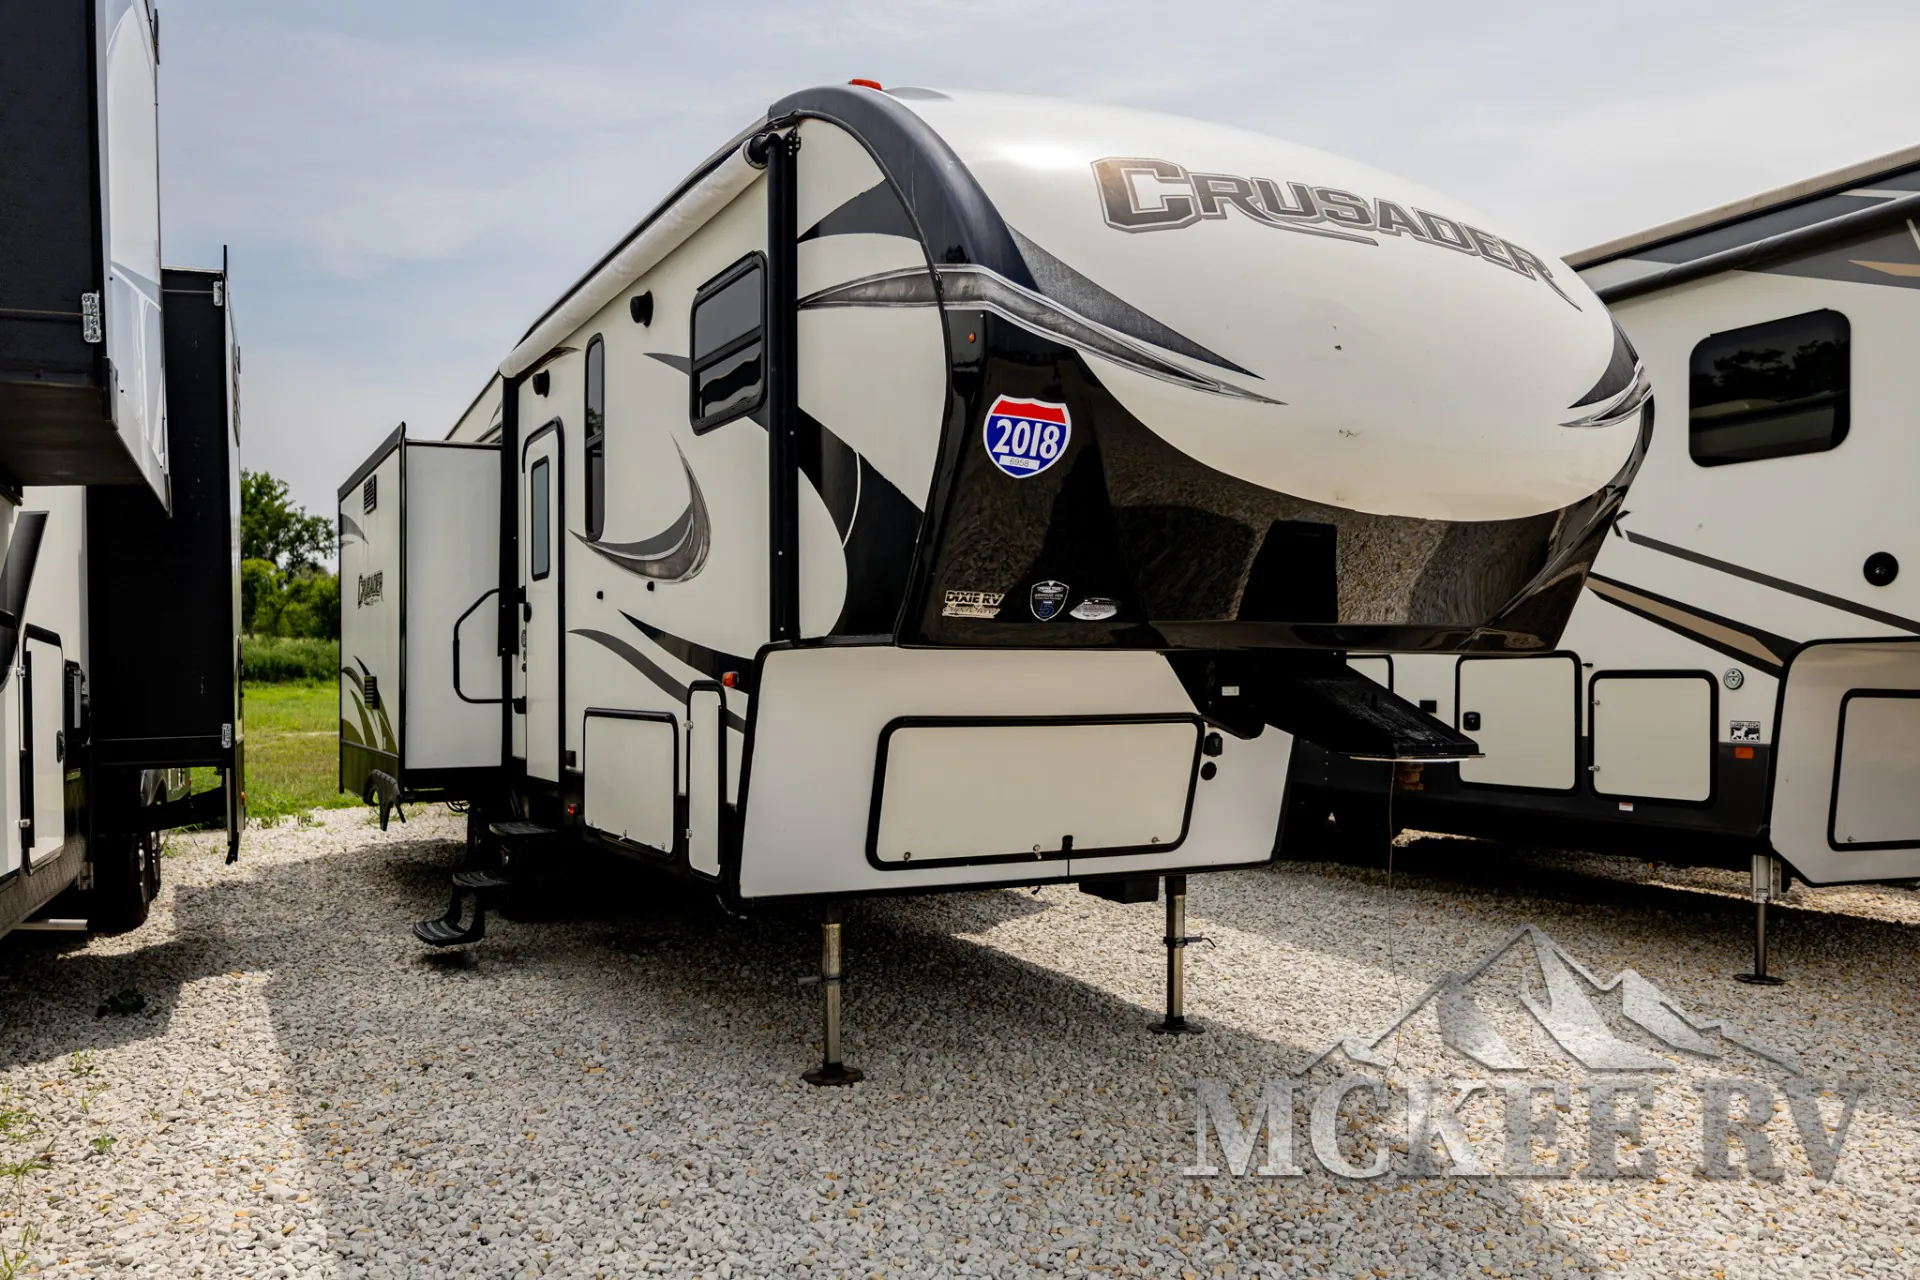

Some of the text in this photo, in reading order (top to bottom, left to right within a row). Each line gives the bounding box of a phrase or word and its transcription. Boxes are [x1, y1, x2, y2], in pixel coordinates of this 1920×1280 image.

[1090, 156, 1583, 312] CRUSADER
[992, 418, 1060, 460] 2018
[945, 590, 1003, 605] DIXIE RV
[1038, 600, 1055, 617] 5
